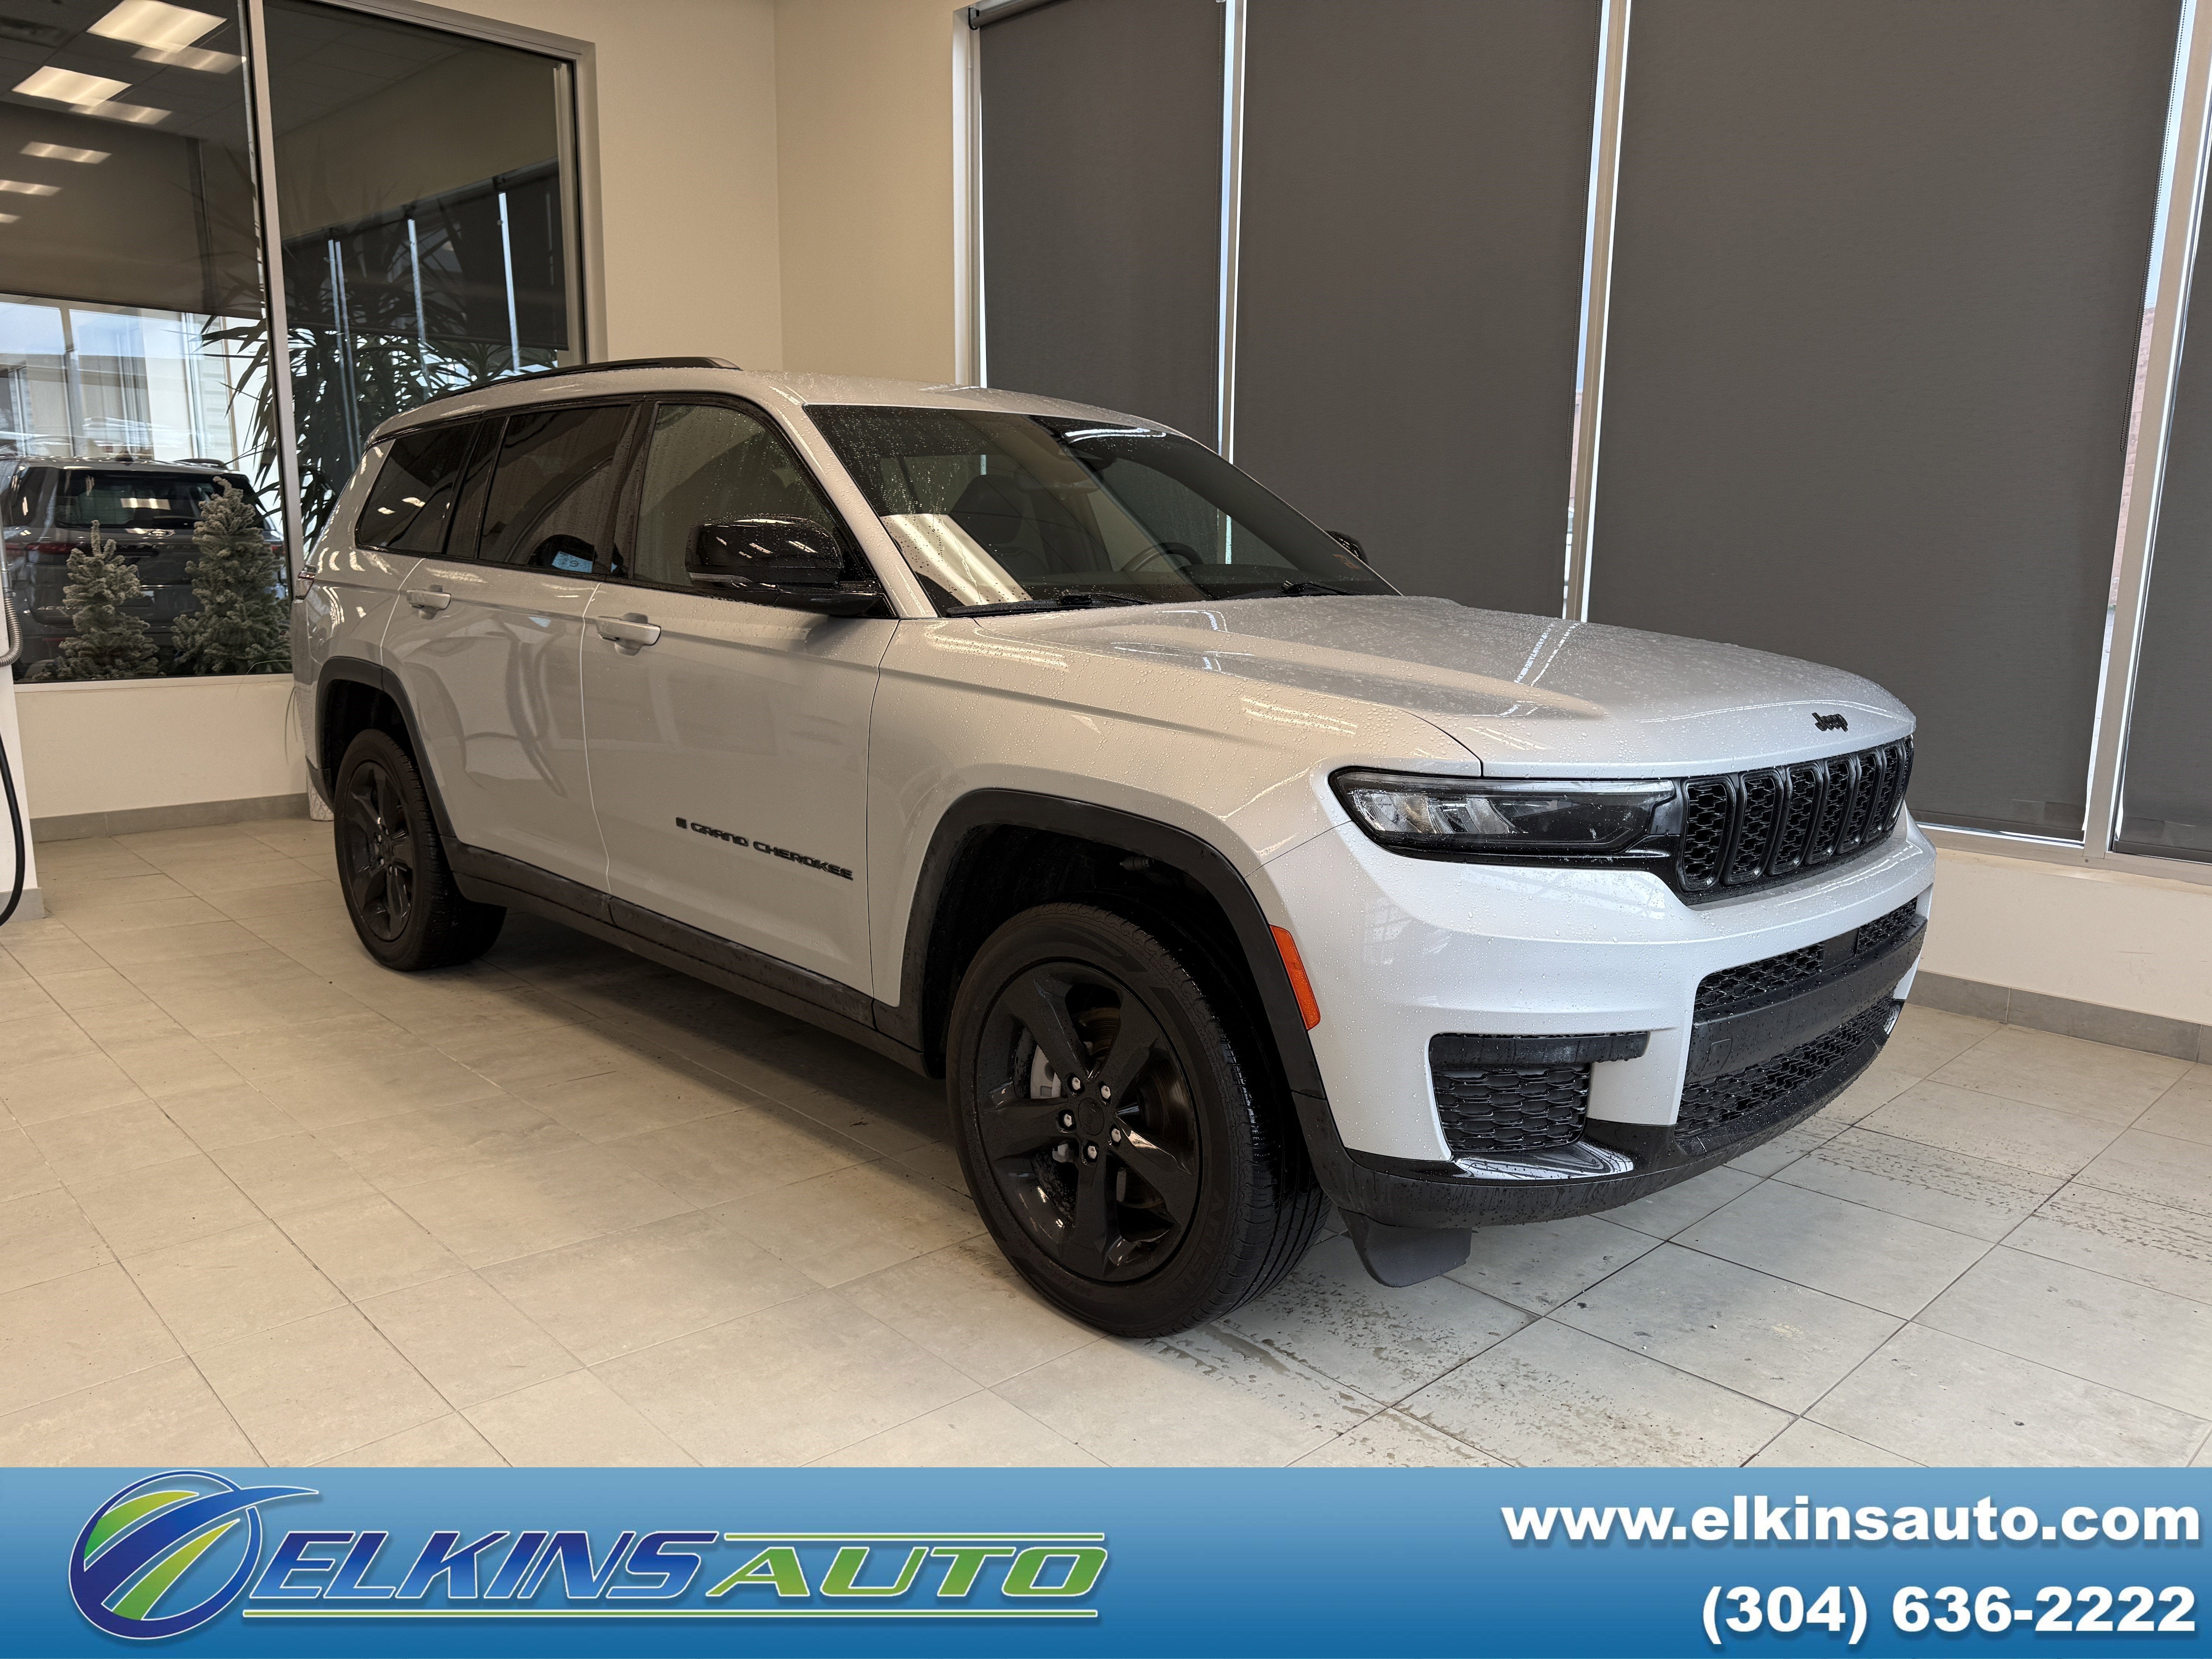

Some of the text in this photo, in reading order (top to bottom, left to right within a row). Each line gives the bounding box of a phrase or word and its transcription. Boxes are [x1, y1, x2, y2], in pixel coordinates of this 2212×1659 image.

[1812, 712, 1848, 732] Jeep
[690, 822, 853, 881] GRAND CHEROKEE
